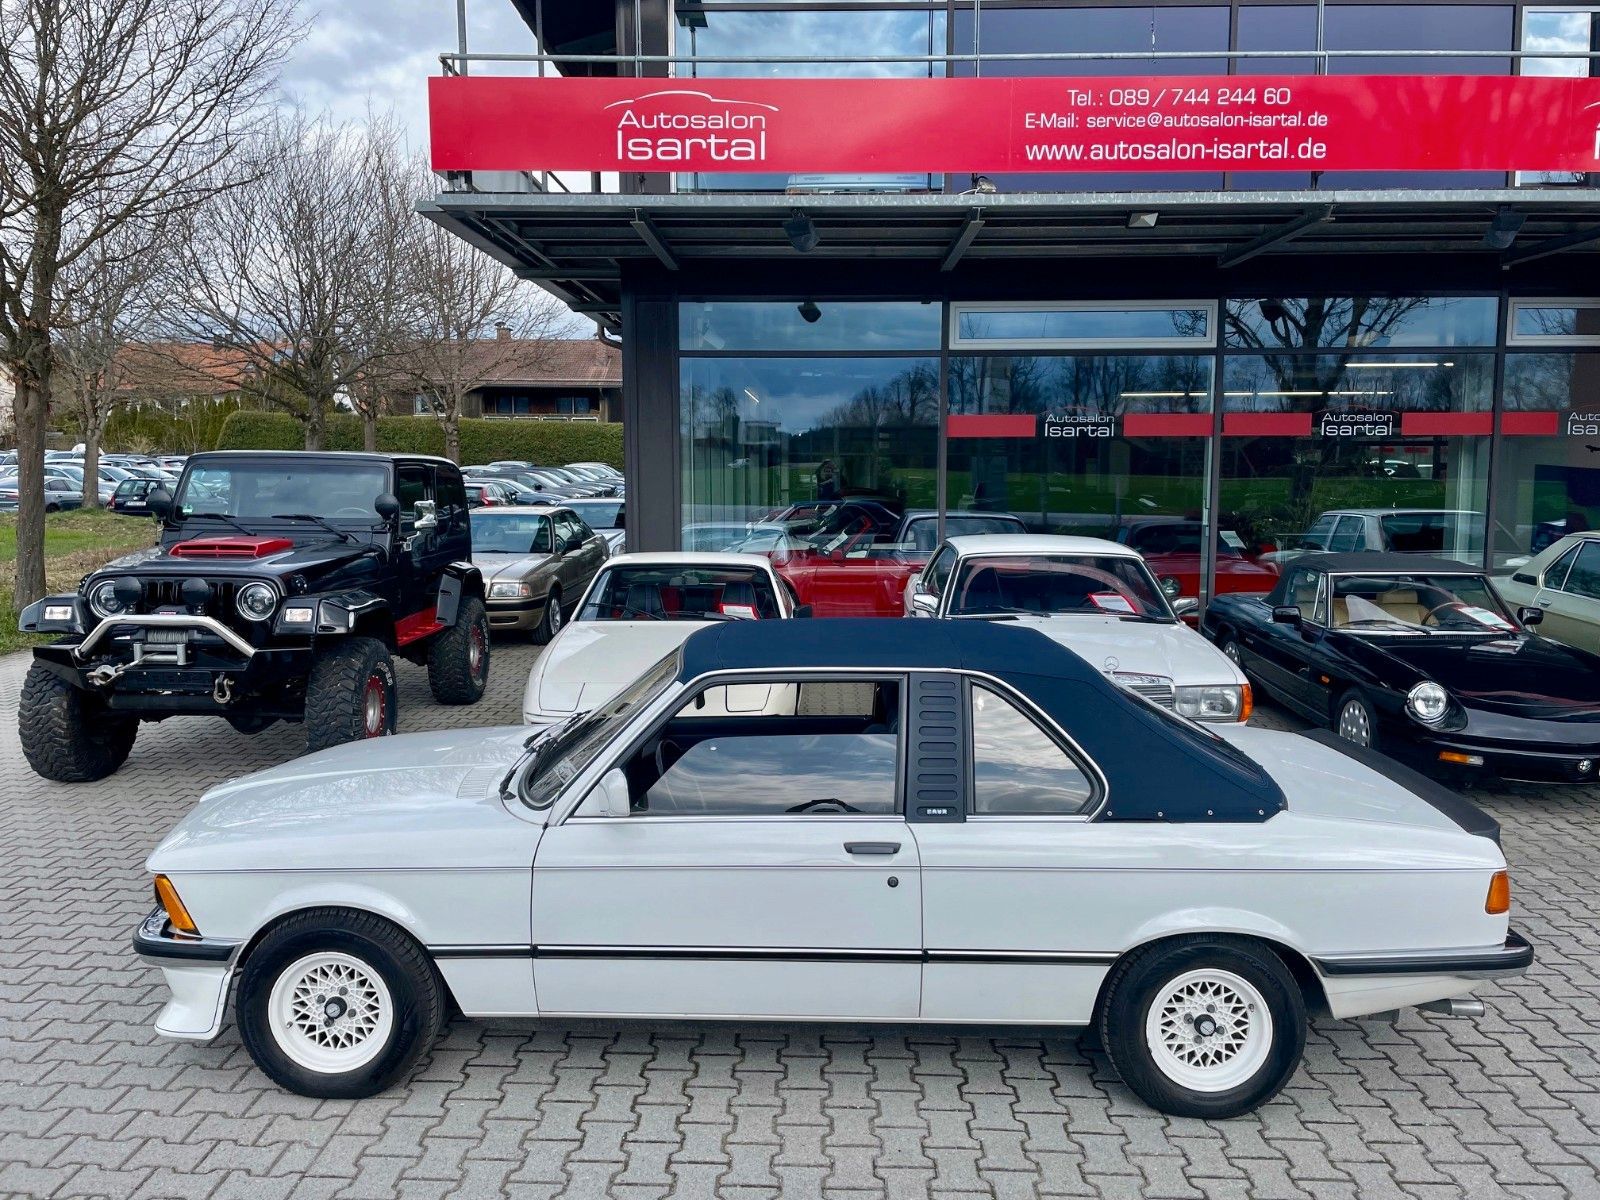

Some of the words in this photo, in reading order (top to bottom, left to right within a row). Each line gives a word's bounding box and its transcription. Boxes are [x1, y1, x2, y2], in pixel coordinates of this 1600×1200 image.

[1066, 89, 1103, 106] Tel.:
[1217, 87, 1257, 105] 244
[1263, 87, 1291, 105] 60
[617, 109, 766, 129] Autosalon
[1025, 112, 1080, 129] E-Mail:
[1086, 111, 1328, 128] service@autosalon-isartal.de
[617, 130, 766, 161] Isartal
[1025, 137, 1327, 161] www.autosalon-isartal.de
[1045, 413, 1115, 423] Autosalon
[1322, 412, 1393, 422] Autosalon
[1044, 423, 1115, 437] Isartal
[1321, 422, 1393, 436] Isartal
